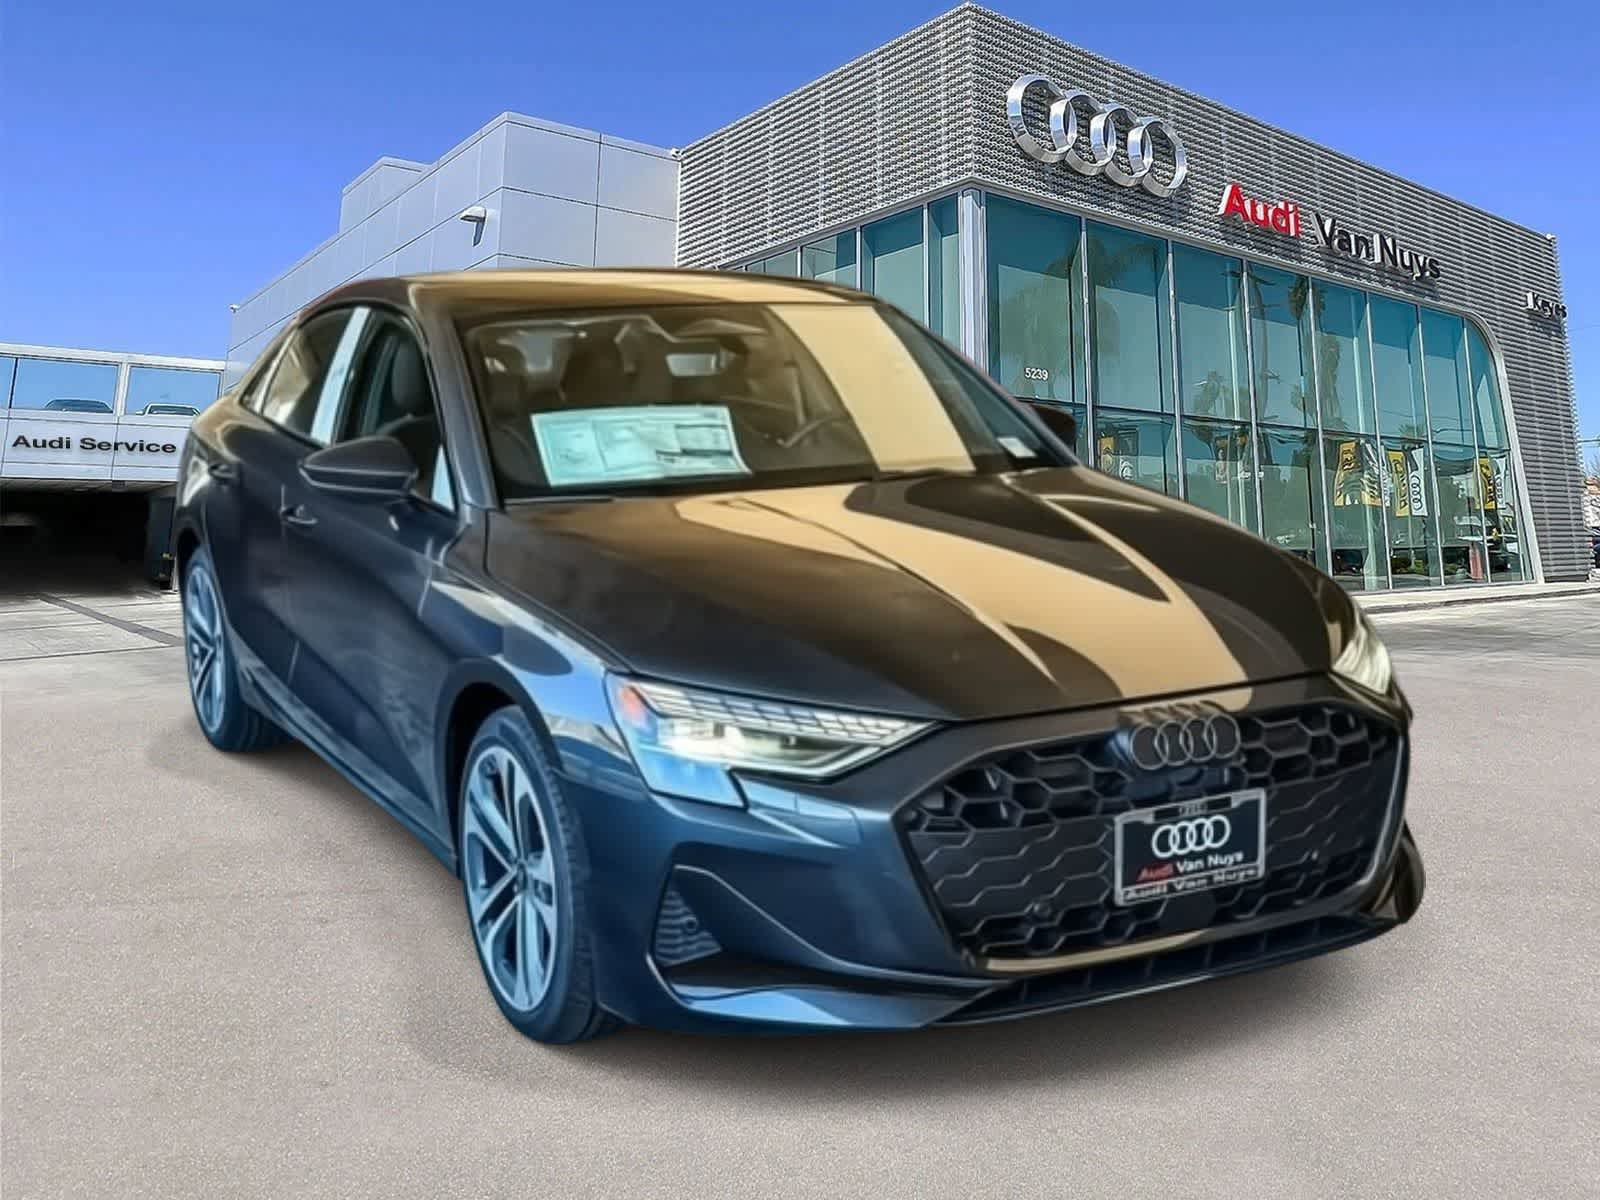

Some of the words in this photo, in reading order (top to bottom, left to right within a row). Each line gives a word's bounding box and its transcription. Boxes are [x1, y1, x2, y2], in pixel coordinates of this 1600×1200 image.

[1217, 183, 1302, 238] Audi
[1310, 211, 1372, 260] Van
[1373, 233, 1441, 280] Nuys
[1024, 367, 1049, 381] 5239
[12, 435, 71, 450] Audi
[79, 437, 177, 454] Service
[1175, 859, 1205, 874] Van
[1206, 851, 1244, 868] Nuys
